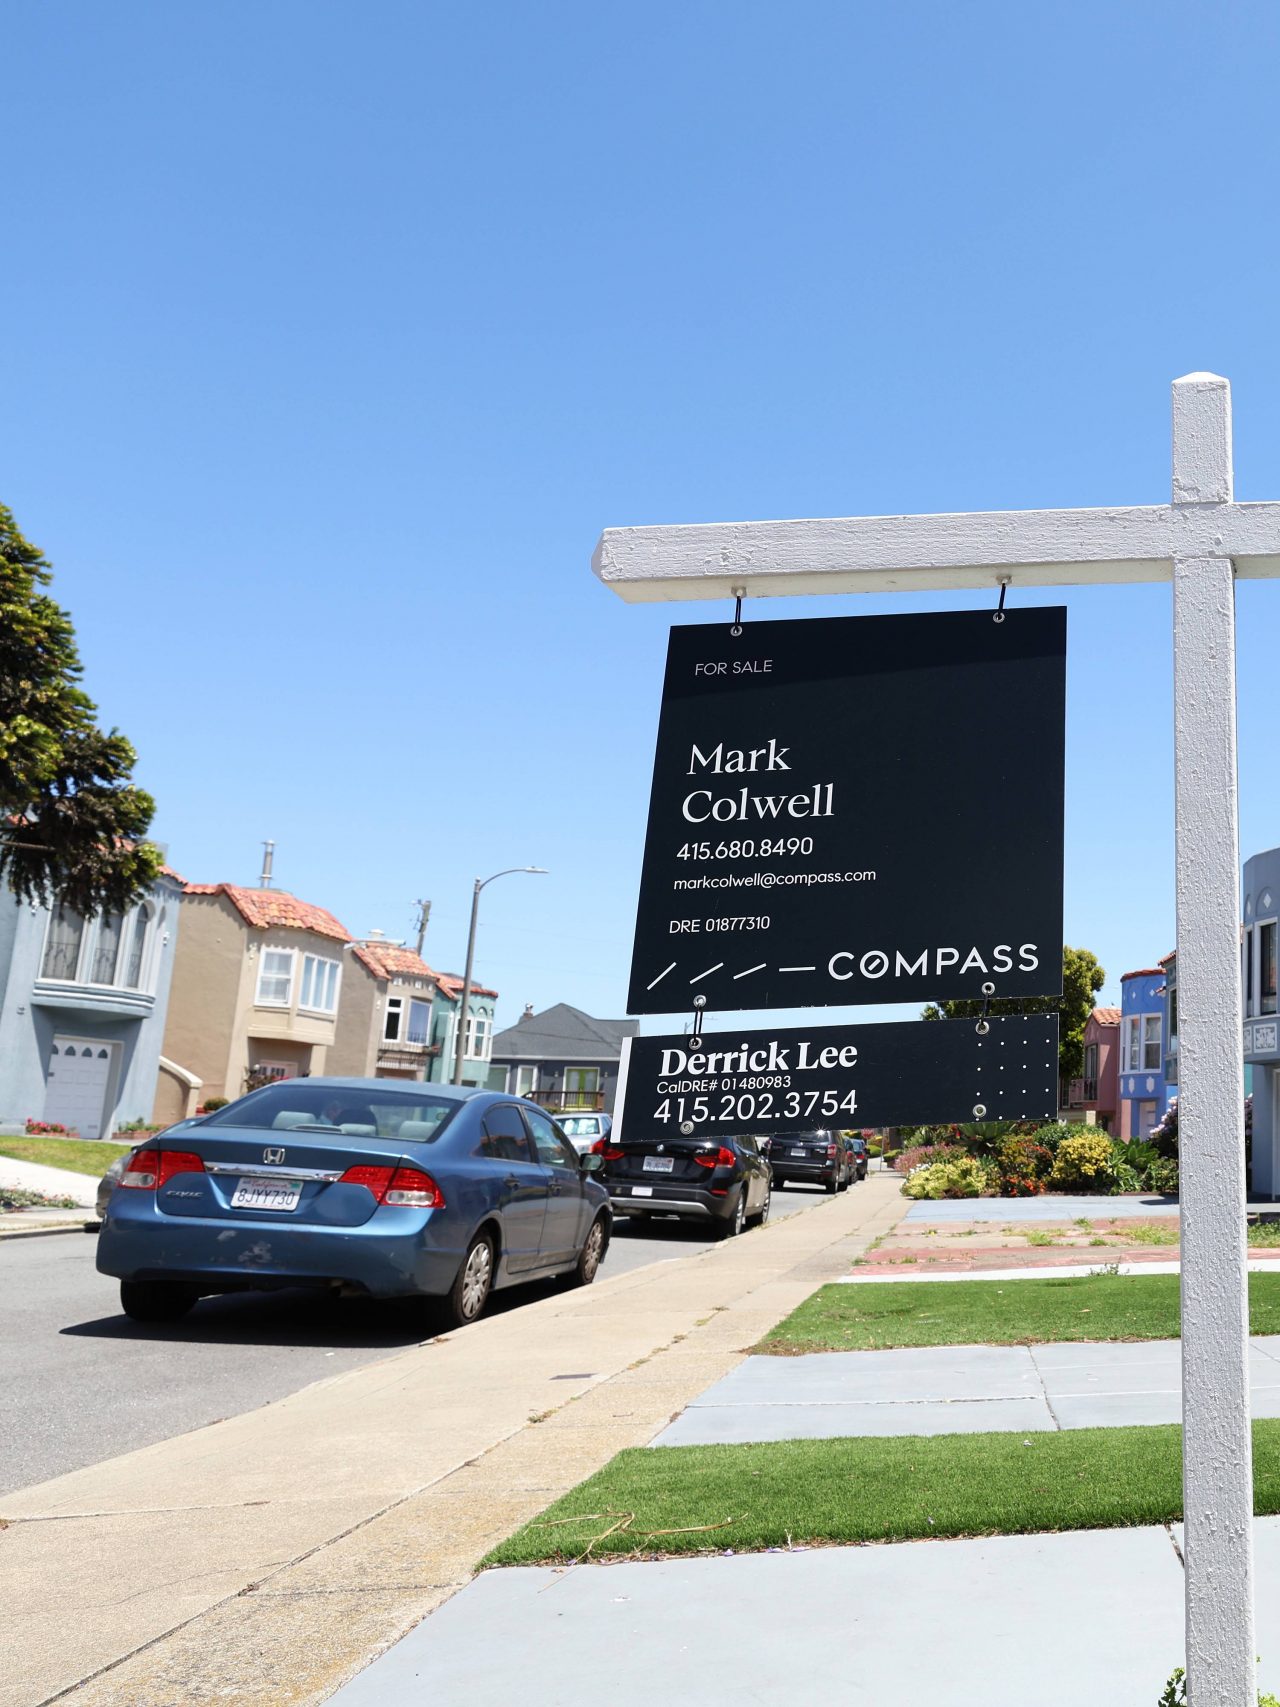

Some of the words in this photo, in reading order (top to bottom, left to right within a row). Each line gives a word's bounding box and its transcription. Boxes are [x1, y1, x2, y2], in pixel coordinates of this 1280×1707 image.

[695, 662, 728, 676] FOR
[732, 659, 773, 674] SALE
[686, 738, 793, 775] Mark
[682, 782, 835, 823] Colwell
[676, 836, 814, 861] 415.680.8490
[673, 870, 877, 890] markcolwell@compass.com
[669, 919, 701, 934] DRE
[705, 915, 771, 932] 01877310
[827, 943, 1039, 981] COMPASS
[658, 1040, 791, 1077] Derrick
[795, 1041, 858, 1070] Lee
[656, 1078, 719, 1094] CalDRE#
[721, 1075, 792, 1091] 01480983
[653, 1089, 858, 1124] 415.202.3754
[237, 1188, 295, 1206] 8JYY730
